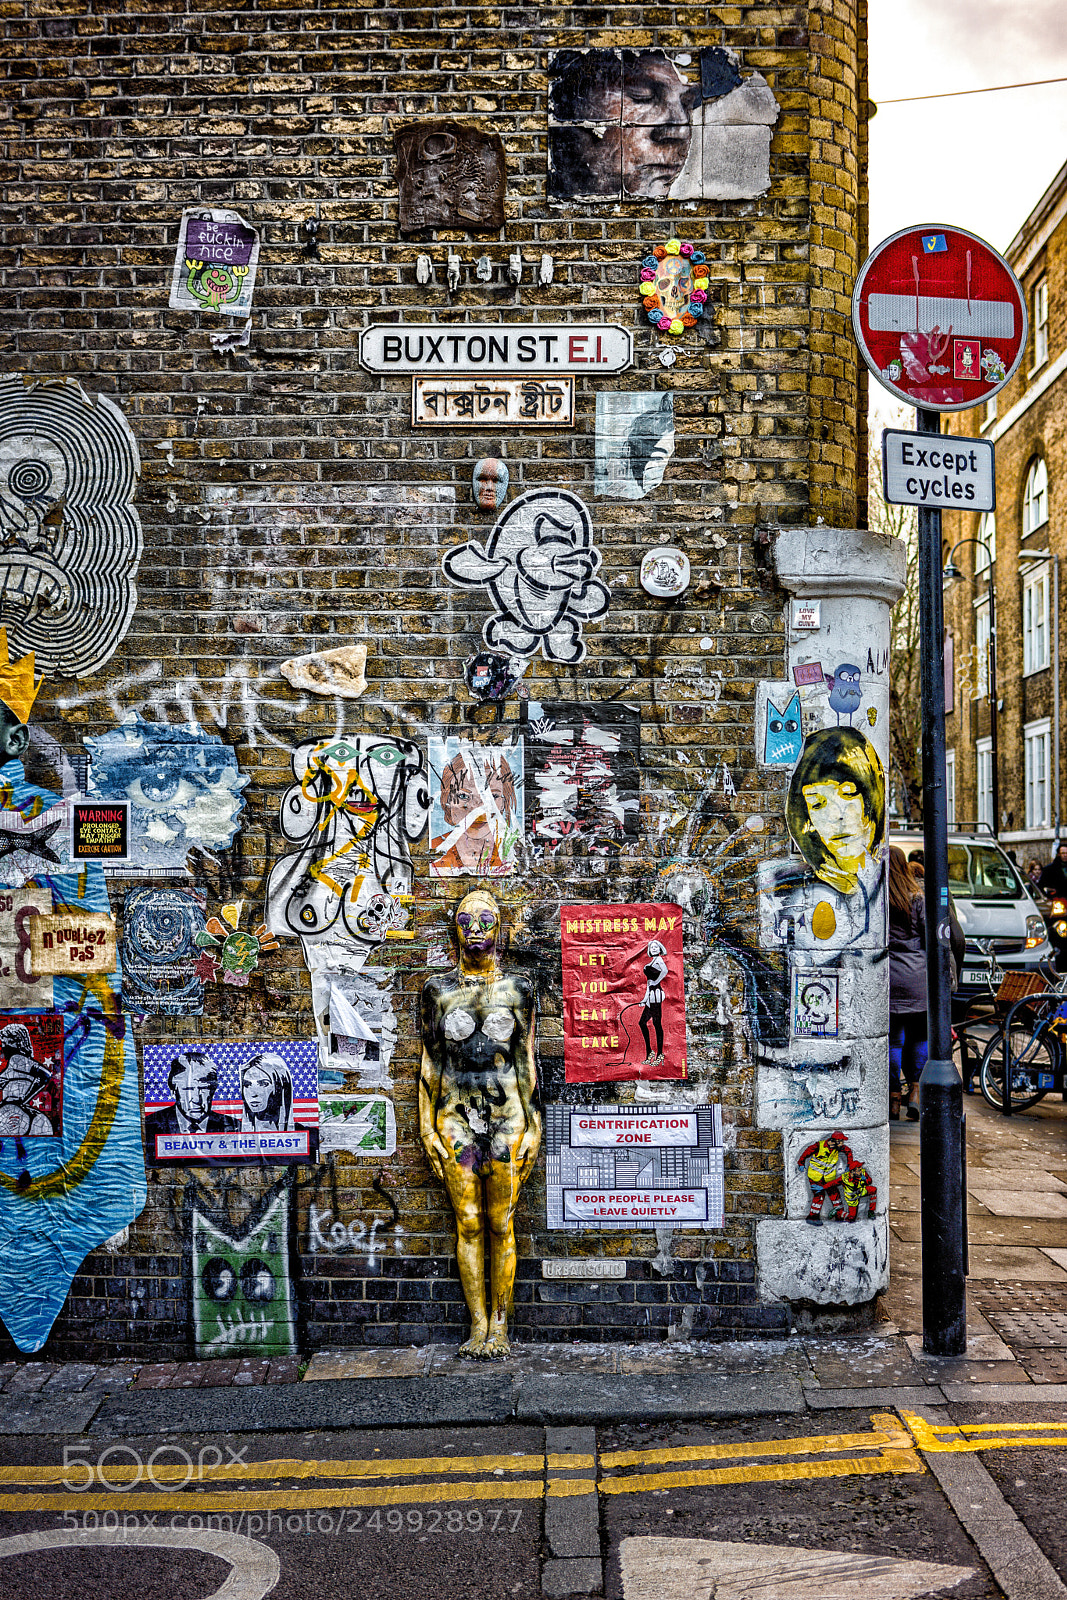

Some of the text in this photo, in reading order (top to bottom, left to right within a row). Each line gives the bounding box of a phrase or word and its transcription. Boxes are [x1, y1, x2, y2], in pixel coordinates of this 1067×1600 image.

[206, 223, 219, 232] be
[198, 232, 244, 249] fuckin
[200, 244, 233, 261] nice
[383, 335, 508, 363] BUXTON
[516, 335, 559, 363] ST.
[901, 441, 978, 475] Except
[906, 475, 975, 500] cycles
[78, 809, 123, 822] WARNING
[78, 844, 122, 853] EXERCISE CAUTION
[566, 917, 677, 934] MISTRESS MAY
[579, 954, 607, 966] LET
[580, 981, 608, 993] YOU
[581, 1009, 609, 1021] EAT
[581, 1036, 619, 1048] CAKE
[578, 1119, 689, 1130] GENTRIFICATION
[164, 1138, 301, 1150] BEAUTY & THE BEAST
[615, 1133, 652, 1143] ZONE
[575, 1194, 695, 1203] POOR PEOPLE PLEASE
[593, 1207, 677, 1216] LEAVE QUIETLY
